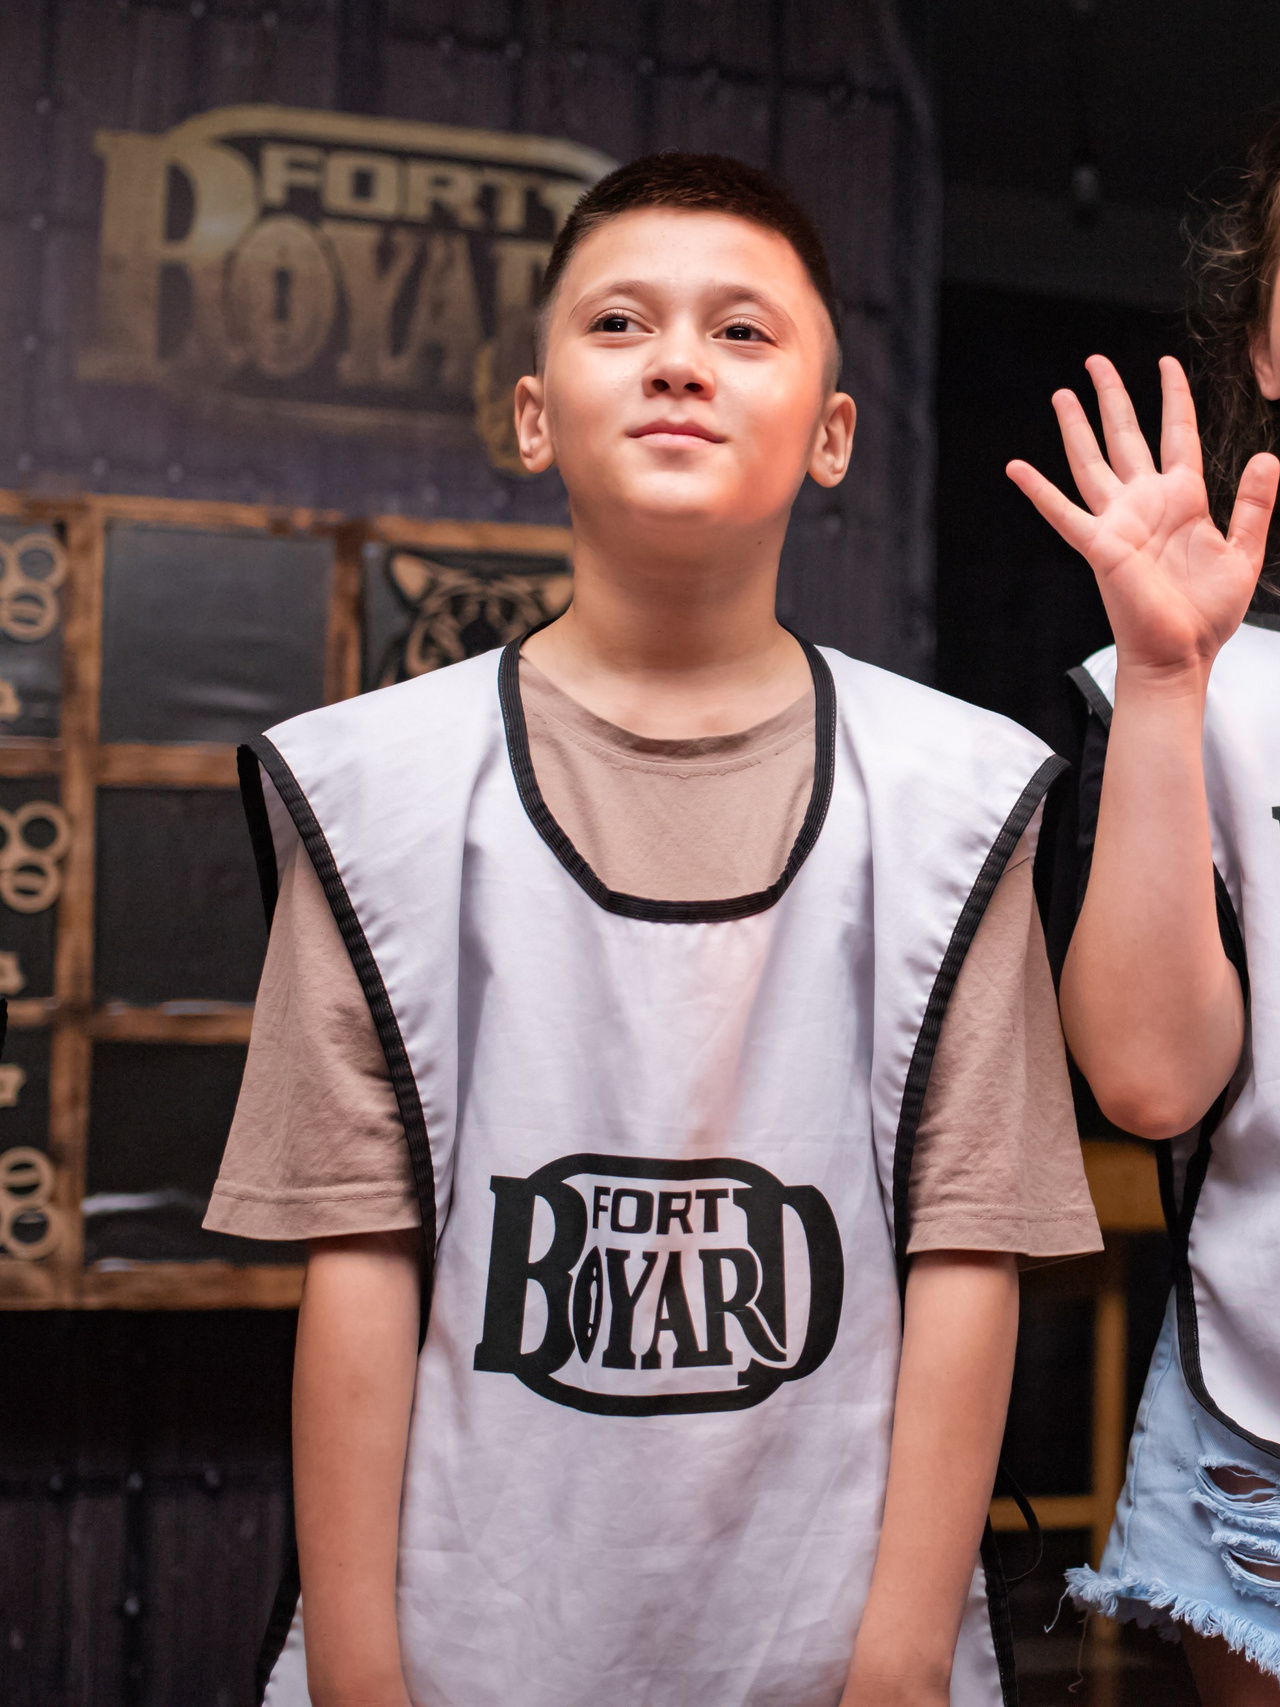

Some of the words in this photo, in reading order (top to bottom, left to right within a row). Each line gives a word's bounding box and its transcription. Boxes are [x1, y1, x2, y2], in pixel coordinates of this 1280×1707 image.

[76, 104, 560, 388] BOYA
[259, 141, 536, 233] FORT
[473, 1153, 845, 1417] BOYARD
[592, 1185, 730, 1236] FORT
